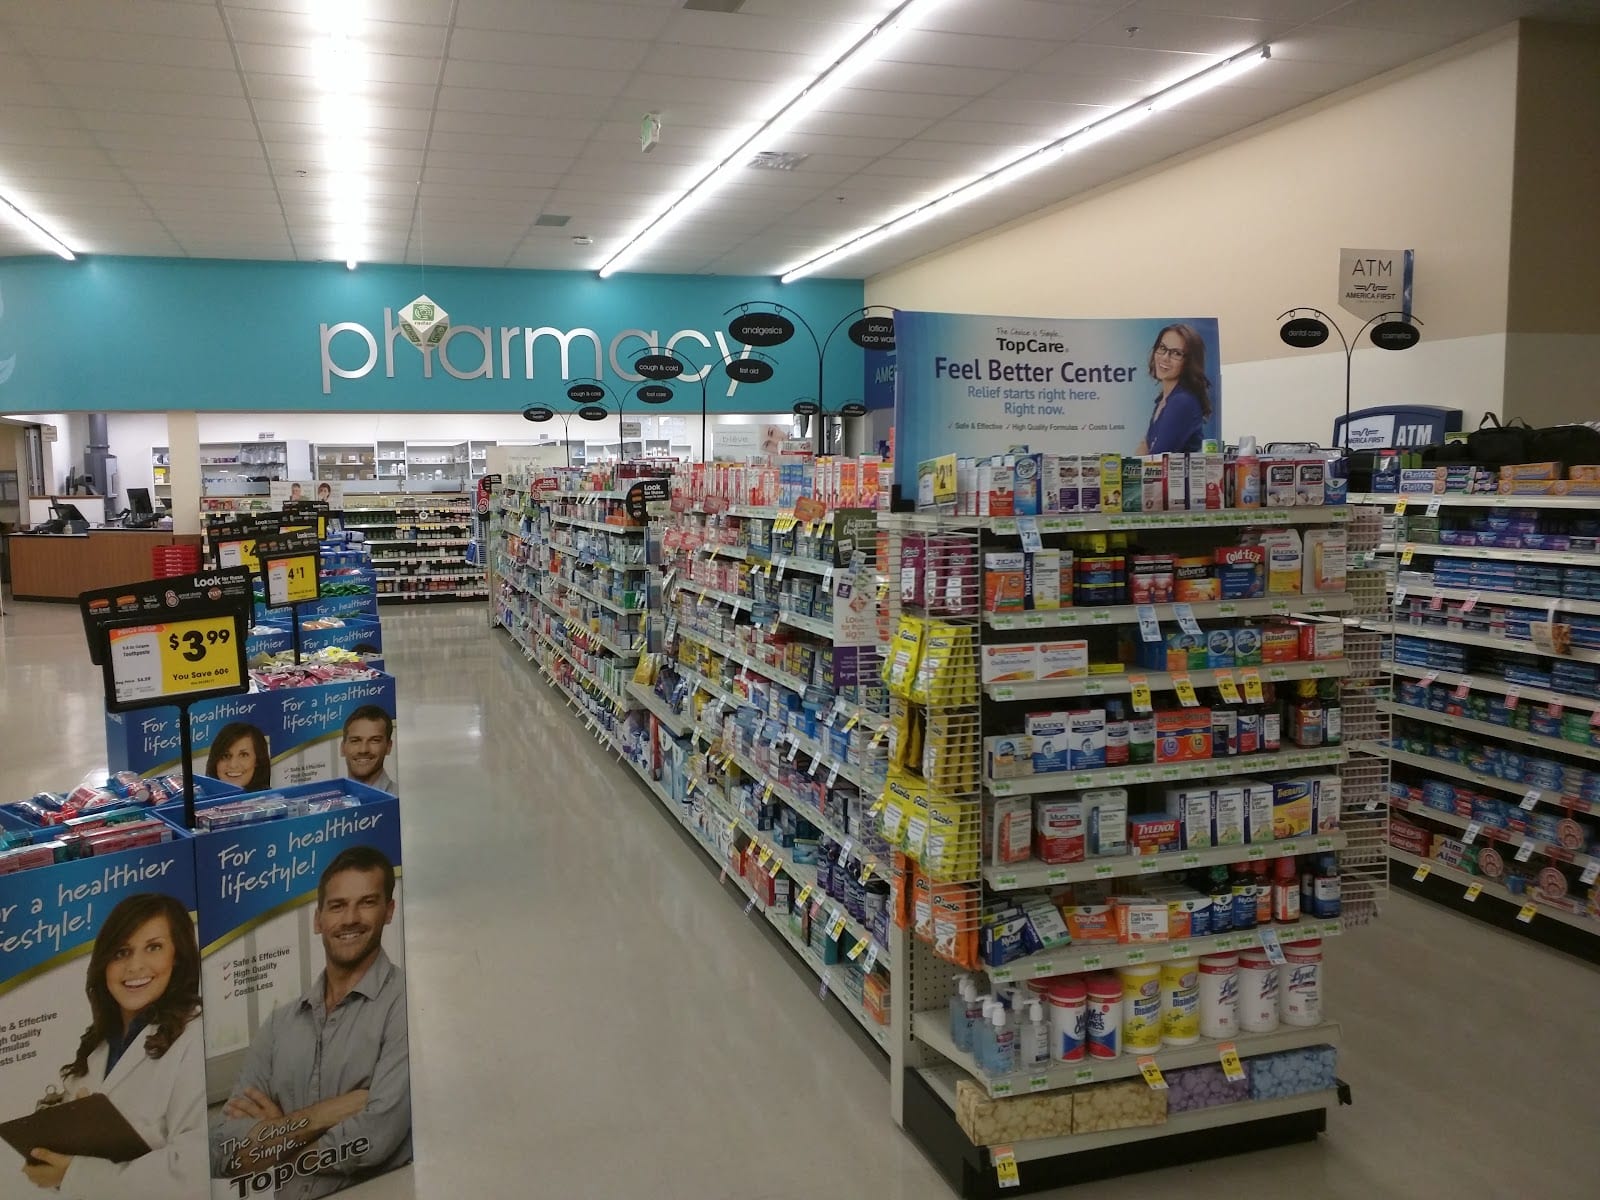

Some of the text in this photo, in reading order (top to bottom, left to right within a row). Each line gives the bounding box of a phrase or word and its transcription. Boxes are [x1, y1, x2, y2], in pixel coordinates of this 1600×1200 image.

[1352, 259, 1392, 277] ATM
[741, 326, 783, 336] analgesics
[868, 325, 888, 333] lotion
[861, 335, 878, 343] face
[996, 337, 1065, 354] TopCare
[320, 307, 753, 397] pharmacy
[639, 364, 658, 373] cough
[665, 364, 679, 372] cold
[935, 357, 1137, 383] Feel Better Center
[967, 385, 1100, 403] Relief starts right here.
[1004, 402, 1065, 417] Right now.
[1012, 424, 1026, 432] High
[1027, 424, 1048, 432] Quality
[1396, 425, 1432, 446] ATM
[1144, 468, 1162, 477] Afrin
[644, 484, 661, 492] Look
[194, 576, 221, 588] Look
[317, 606, 329, 614] For
[338, 599, 372, 611] healthier
[246, 640, 285, 653] ealthier
[302, 639, 317, 649] For
[332, 629, 376, 644] healthier
[191, 671, 212, 679] Save
[214, 668, 229, 676] 60¢
[281, 697, 306, 713] For
[325, 683, 385, 703] healthier
[141, 717, 168, 734] For
[190, 702, 257, 726] healthier
[283, 707, 342, 733] lifestyle!
[143, 725, 209, 756] lifestle!
[890, 782, 910, 800] Ricola
[1138, 823, 1175, 835] TYLENOL
[217, 812, 383, 870] For a healthier
[1443, 839, 1461, 852] Aim
[1438, 851, 1457, 864] Aim
[221, 850, 316, 904] lifestyle!
[31, 898, 42, 914] a
[58, 858, 174, 907] healthier
[0, 903, 92, 951] estyle!
[233, 957, 250, 968] Safe
[259, 947, 290, 962] Effective
[233, 962, 277, 979] High Quality
[233, 973, 268, 986] Formulas
[234, 980, 273, 997] Costs Less
[18, 1011, 57, 1028] Effective
[9, 1028, 42, 1043] Quality
[16, 1050, 37, 1061] Less
[219, 1117, 310, 1156] The Choice
[230, 1137, 307, 1170] is Simple...
[230, 1137, 370, 1199] TopCare
